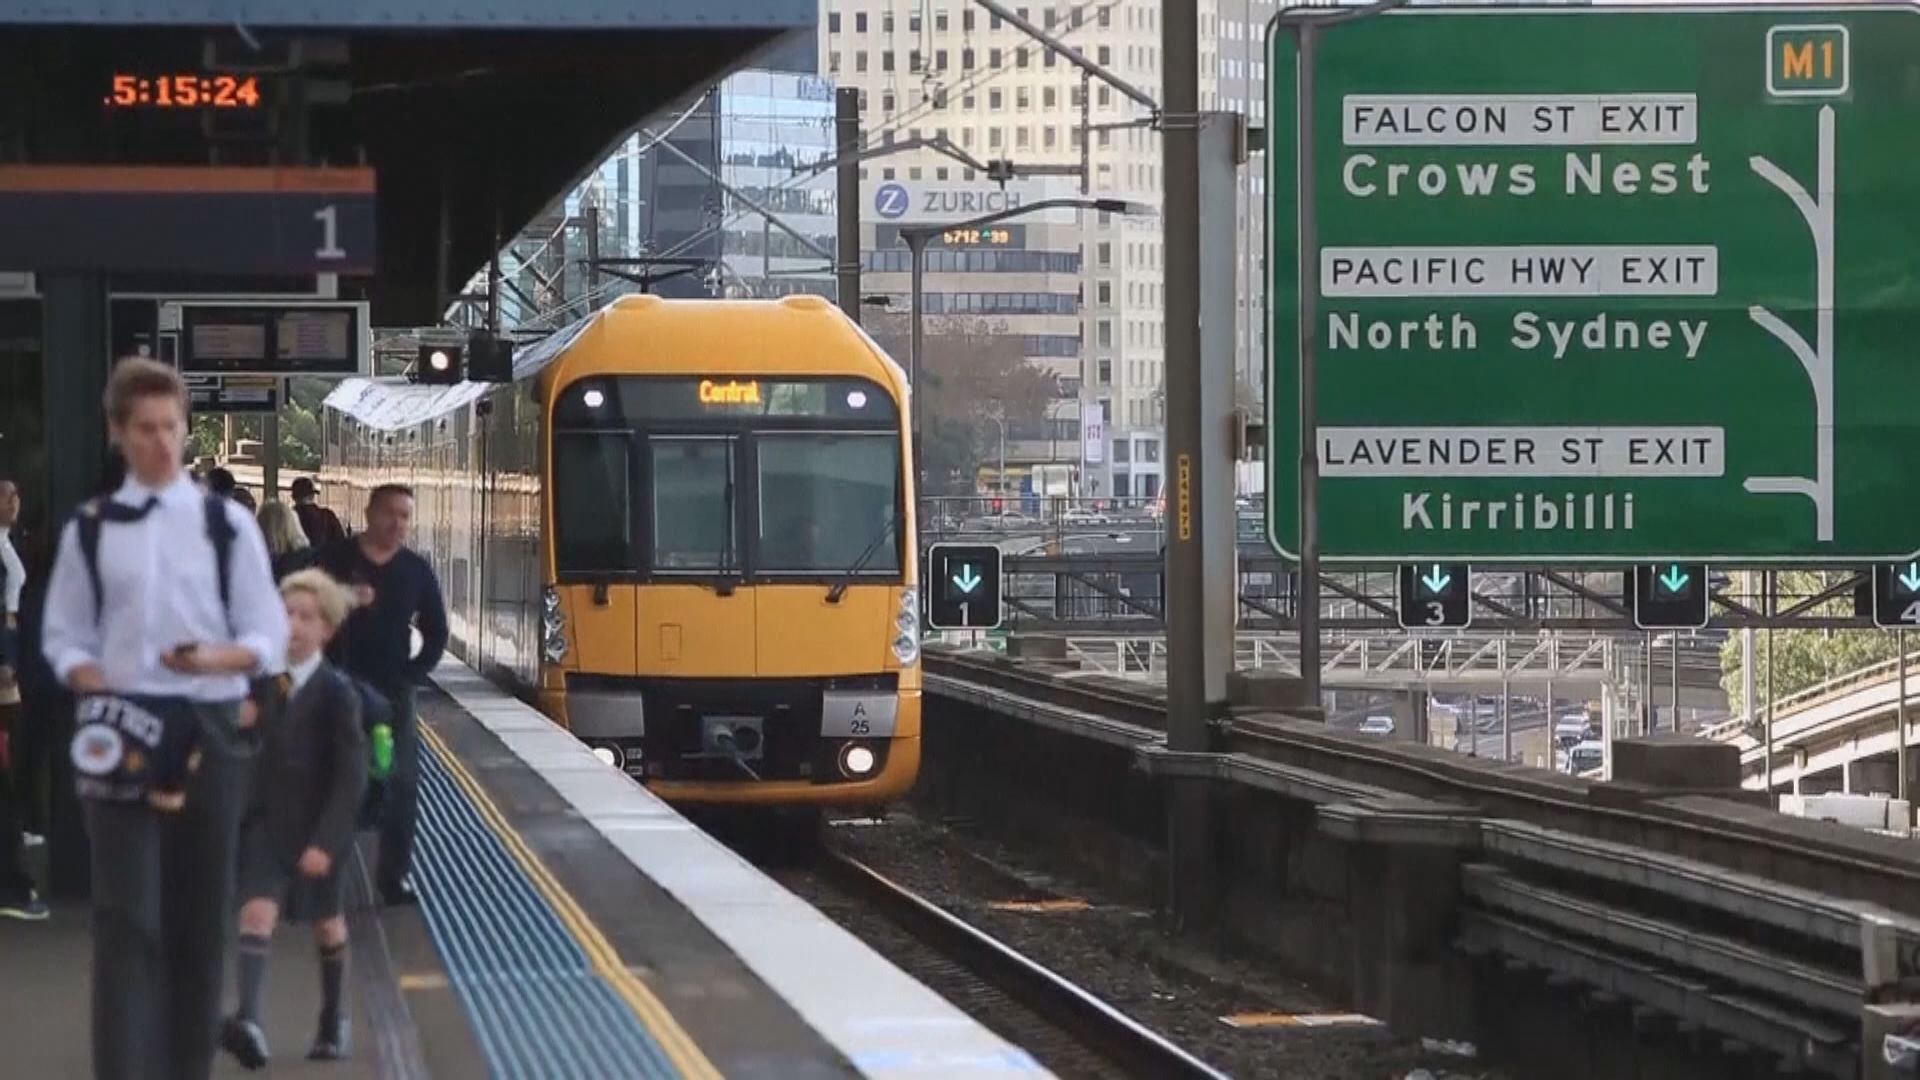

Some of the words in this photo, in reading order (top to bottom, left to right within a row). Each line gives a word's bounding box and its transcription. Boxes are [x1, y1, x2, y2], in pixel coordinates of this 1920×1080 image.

[1783, 40, 1832, 80] M1
[1355, 106, 1506, 134] FALCON
[1533, 106, 1575, 133] ST
[1602, 105, 1685, 132] EXIT
[1343, 153, 1536, 197] Crows
[1565, 152, 1710, 194] Nest
[922, 191, 1020, 212] ZURICH
[315, 205, 346, 258] 1
[1332, 257, 1485, 285] PACIFIC
[1511, 257, 1594, 284] HWY
[1622, 257, 1705, 284] EXIT
[1328, 312, 1477, 350] North
[1511, 311, 1708, 359] Sydney
[700, 380, 759, 403] Central
[1325, 438, 1535, 465] LAVENDER
[1561, 438, 1604, 465] ST
[1629, 438, 1712, 465] EXIT
[1403, 492, 1634, 529] Kirribilli
[960, 602, 968, 626] 1
[1426, 602, 1445, 625] 3
[1901, 601, 1920, 624] 4
[855, 701, 866, 715] A
[851, 720, 870, 735] 25
